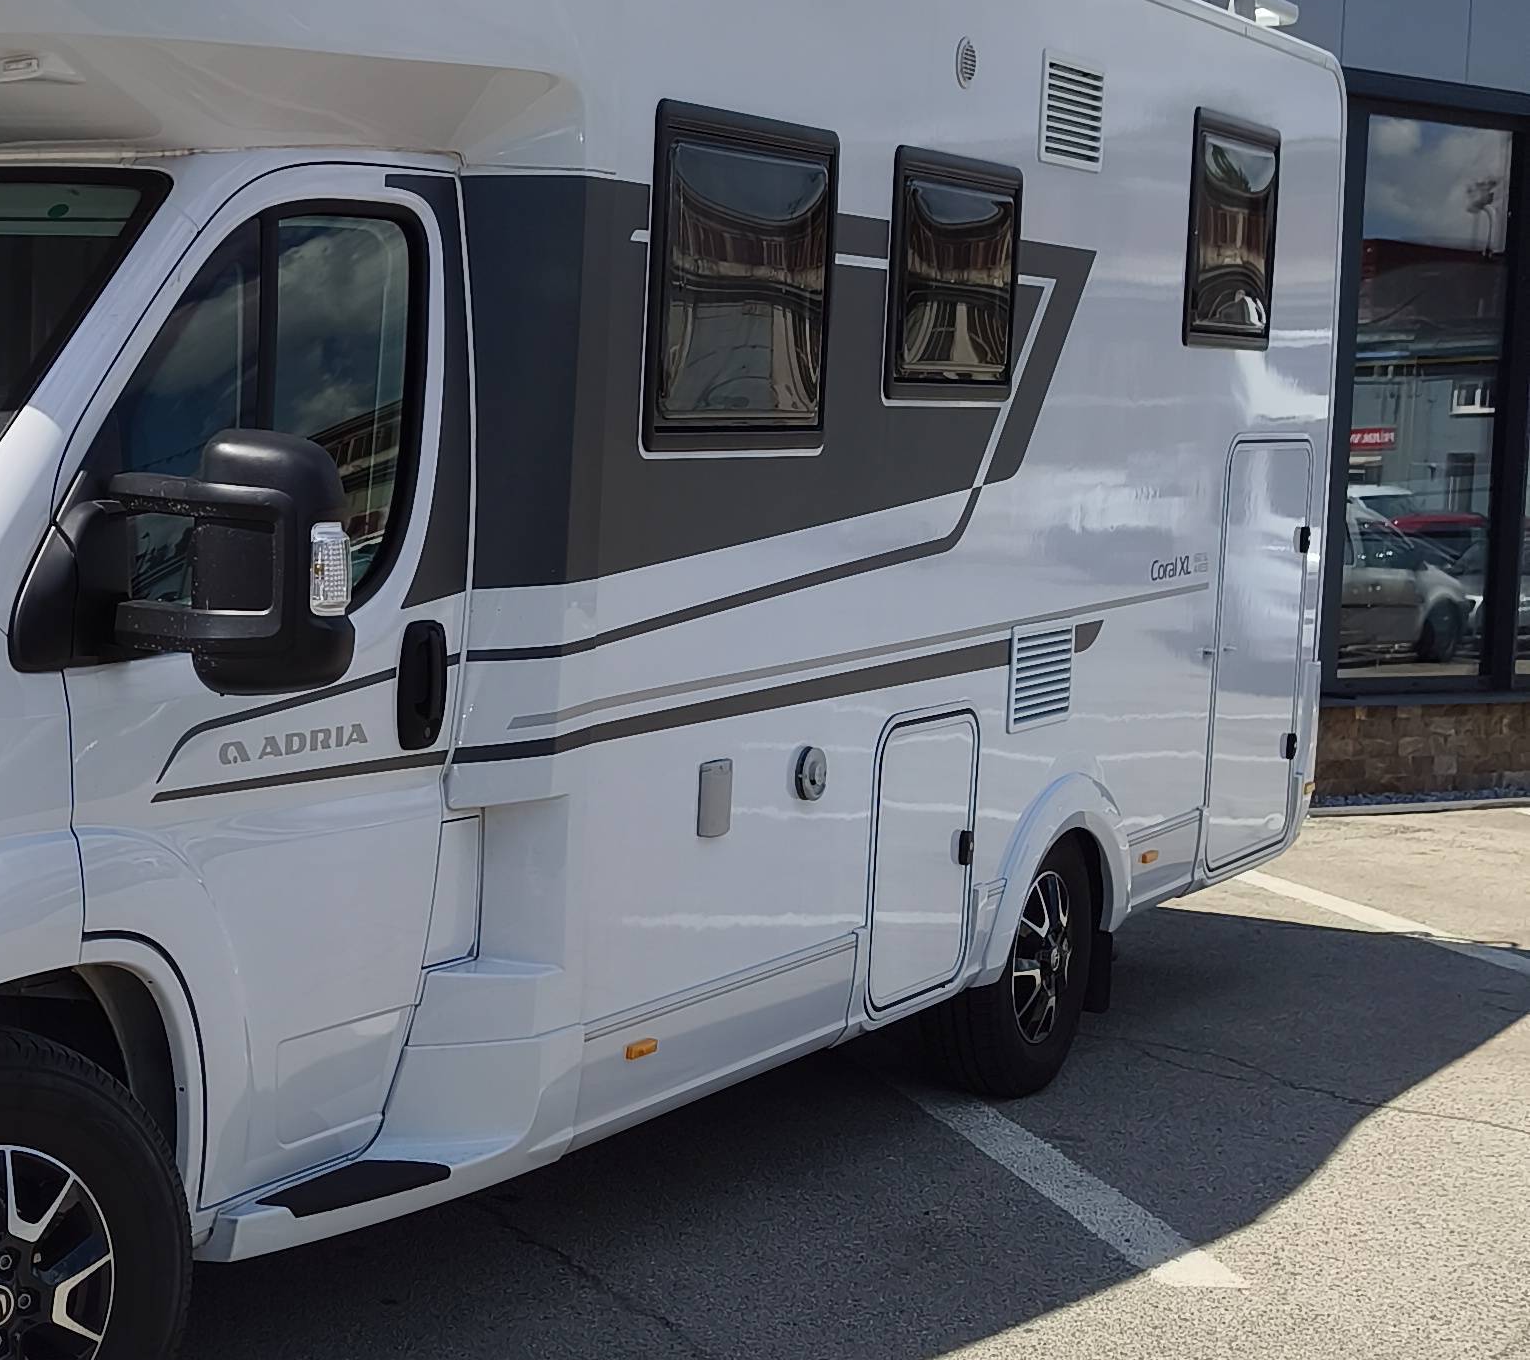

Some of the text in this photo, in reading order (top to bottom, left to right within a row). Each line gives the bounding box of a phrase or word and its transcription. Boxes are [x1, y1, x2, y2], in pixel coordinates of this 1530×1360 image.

[1151, 556, 1178, 581] Coral
[1178, 555, 1192, 577] XL
[258, 723, 368, 759] ADRIA
